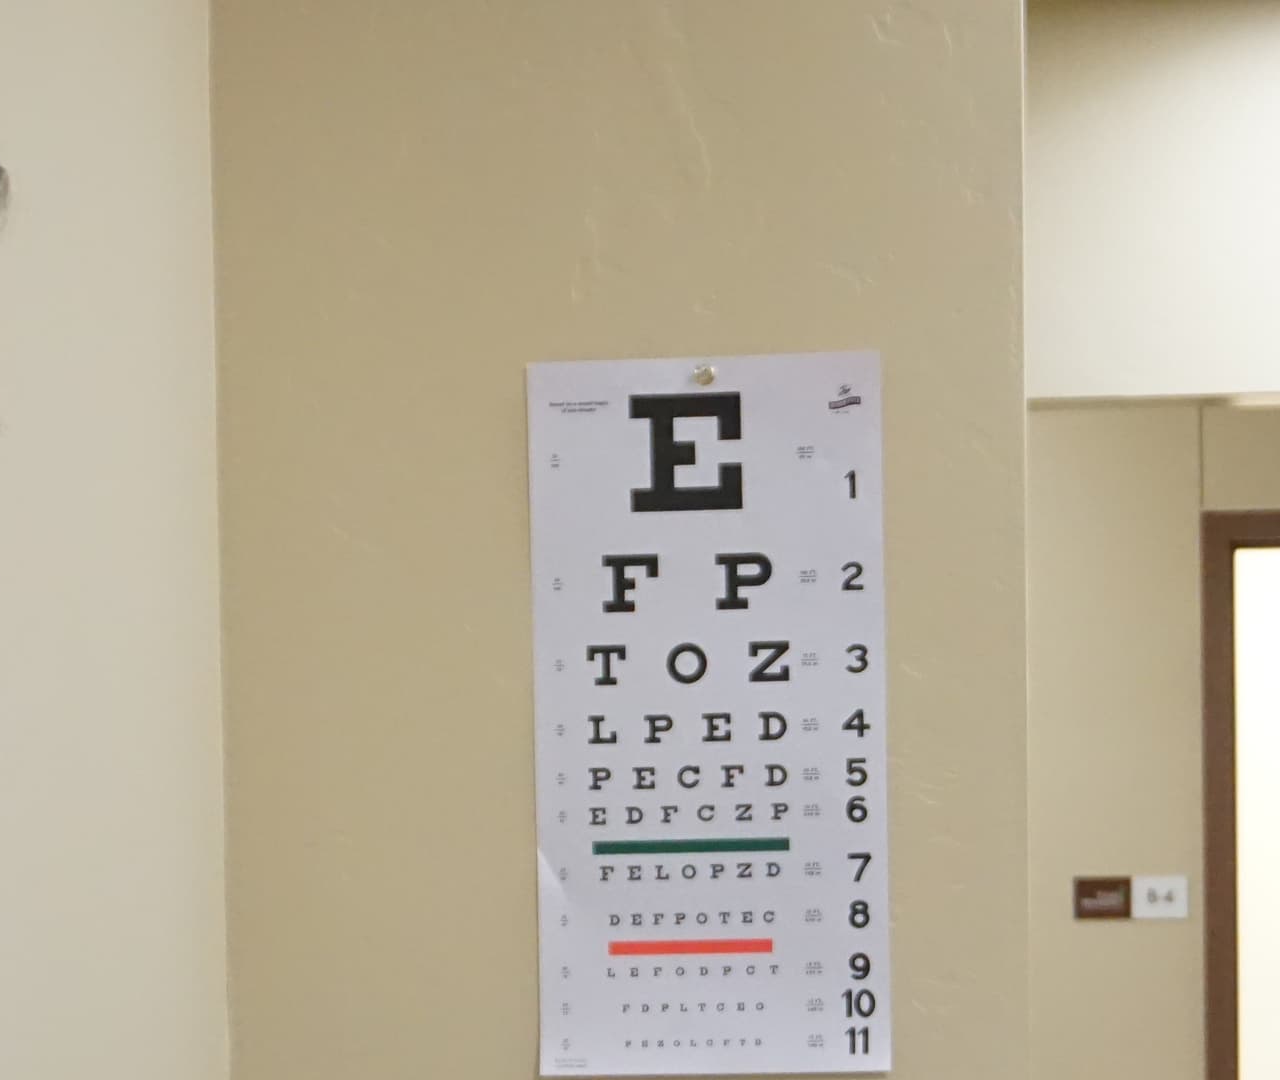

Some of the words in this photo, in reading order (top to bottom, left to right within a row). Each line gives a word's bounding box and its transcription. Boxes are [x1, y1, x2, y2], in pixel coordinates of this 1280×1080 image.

[629, 391, 743, 511] E
[843, 470, 856, 499] 1
[602, 554, 659, 613] F
[715, 552, 773, 610] P
[841, 561, 864, 590] 2
[845, 643, 869, 673] 3
[842, 709, 870, 737] 4
[846, 758, 868, 787] 5
[846, 796, 868, 823] 6
[848, 852, 872, 882] 7
[847, 900, 870, 929] 8
[848, 953, 871, 980] 9
[841, 989, 876, 1018] 10
[845, 1026, 869, 1055] 11
